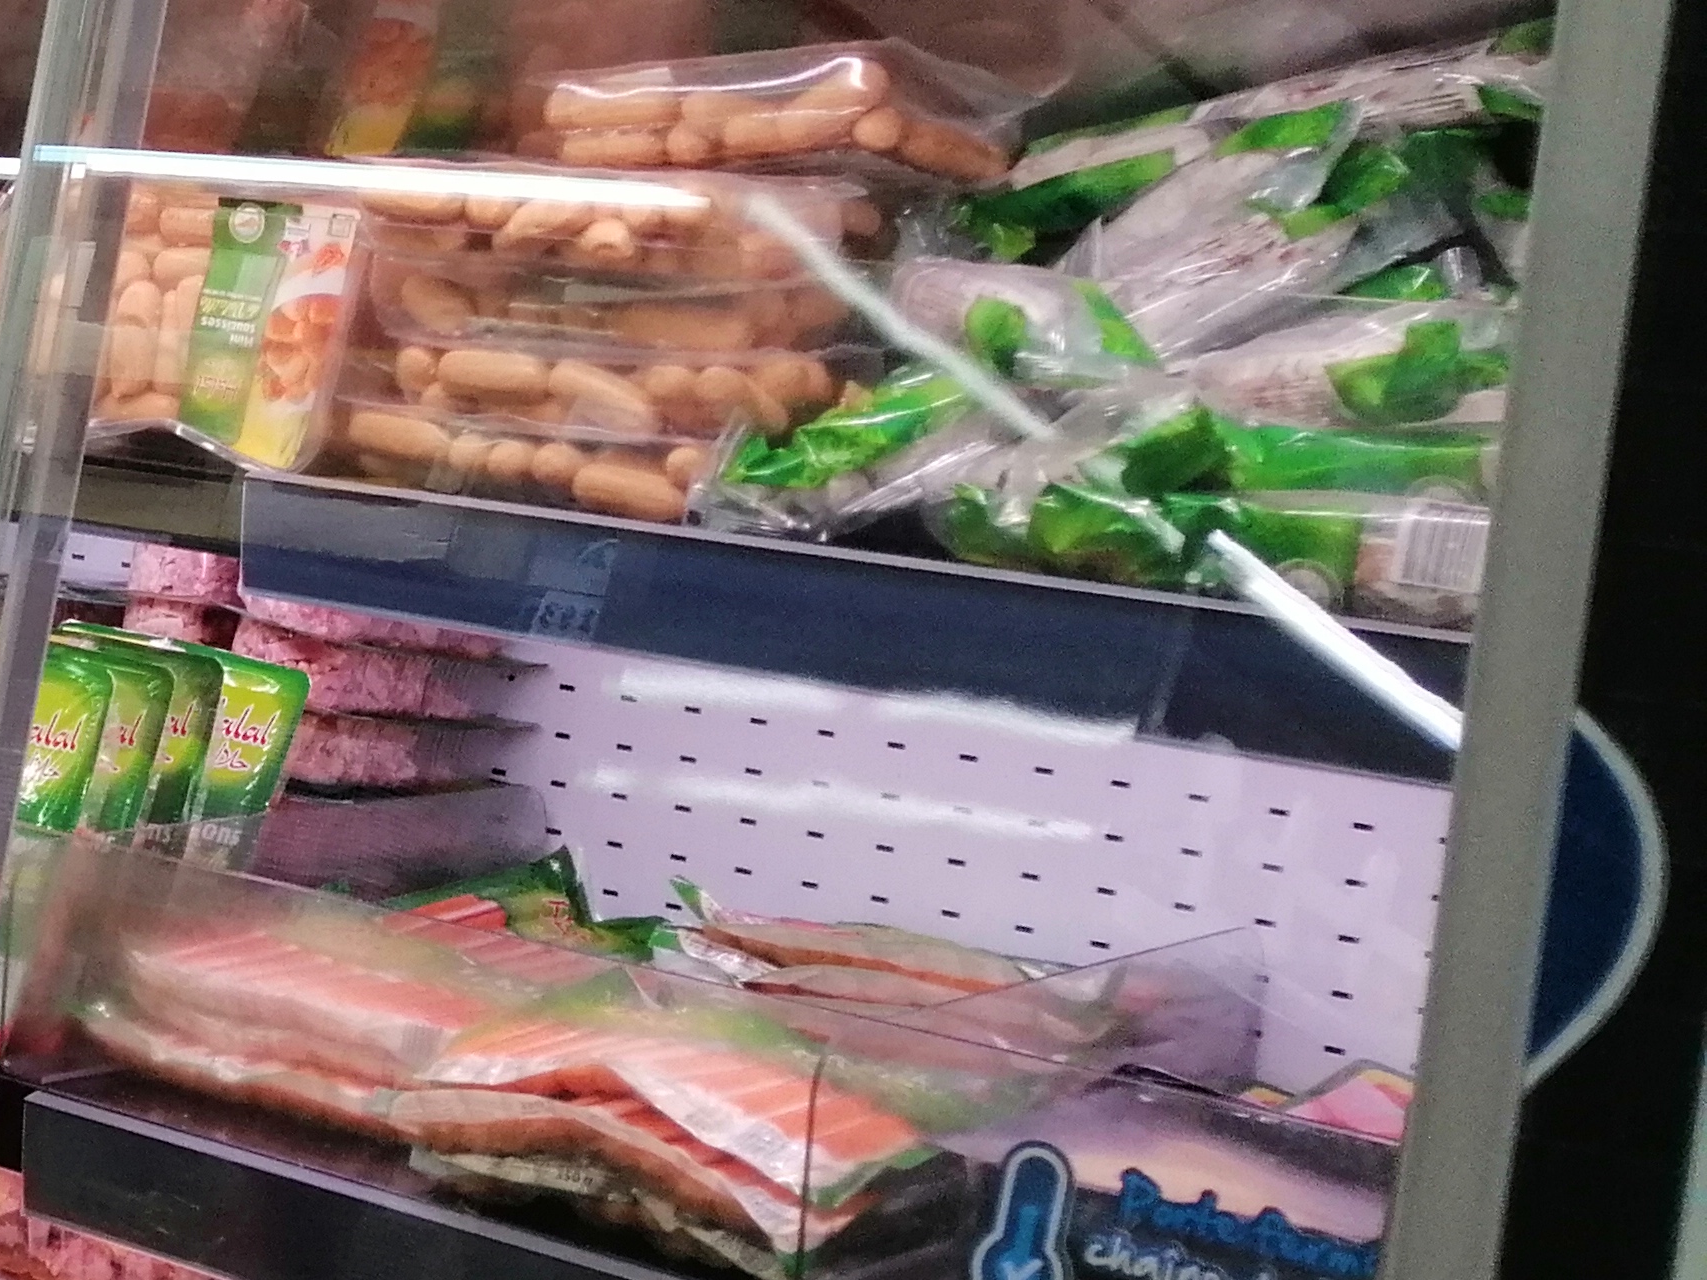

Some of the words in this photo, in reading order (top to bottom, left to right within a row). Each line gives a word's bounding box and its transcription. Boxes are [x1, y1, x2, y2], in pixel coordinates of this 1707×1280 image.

[200, 315, 256, 333] saucisses
[229, 330, 255, 348] Mini
[31, 709, 87, 751] alal
[223, 700, 281, 745] alal
